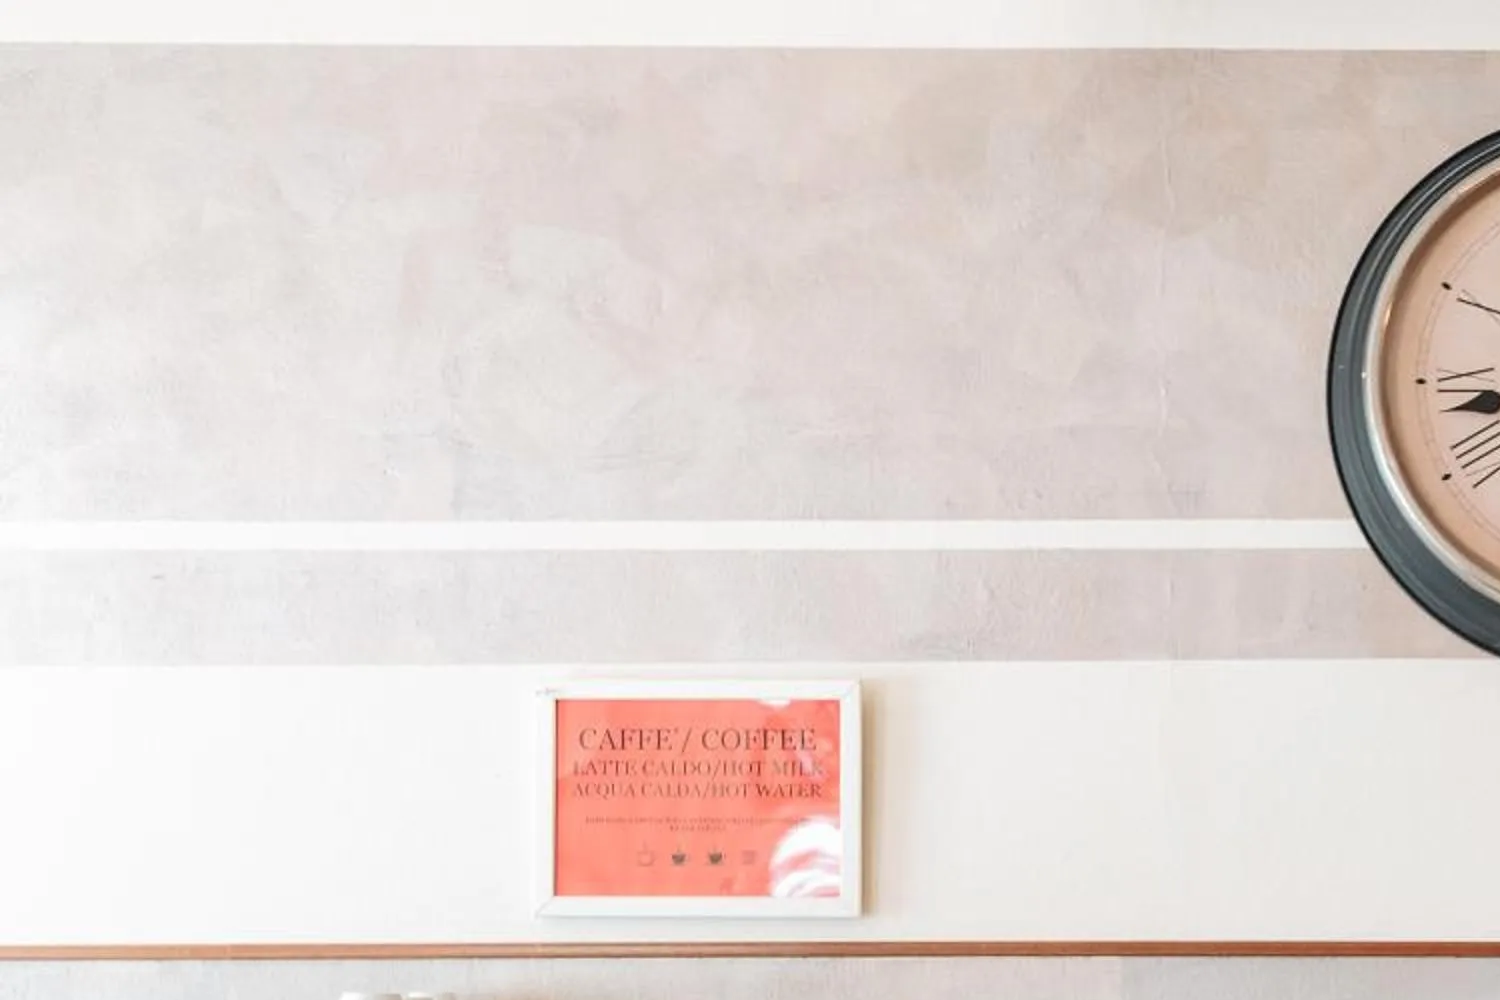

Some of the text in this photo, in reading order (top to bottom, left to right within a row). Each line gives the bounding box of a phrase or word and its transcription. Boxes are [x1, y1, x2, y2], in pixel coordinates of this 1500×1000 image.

[701, 728, 817, 751] COFFEE
[573, 760, 637, 777] LATTE
[772, 760, 824, 777] MILK
[574, 783, 637, 800] ACQUA
[755, 783, 823, 799] WATER
